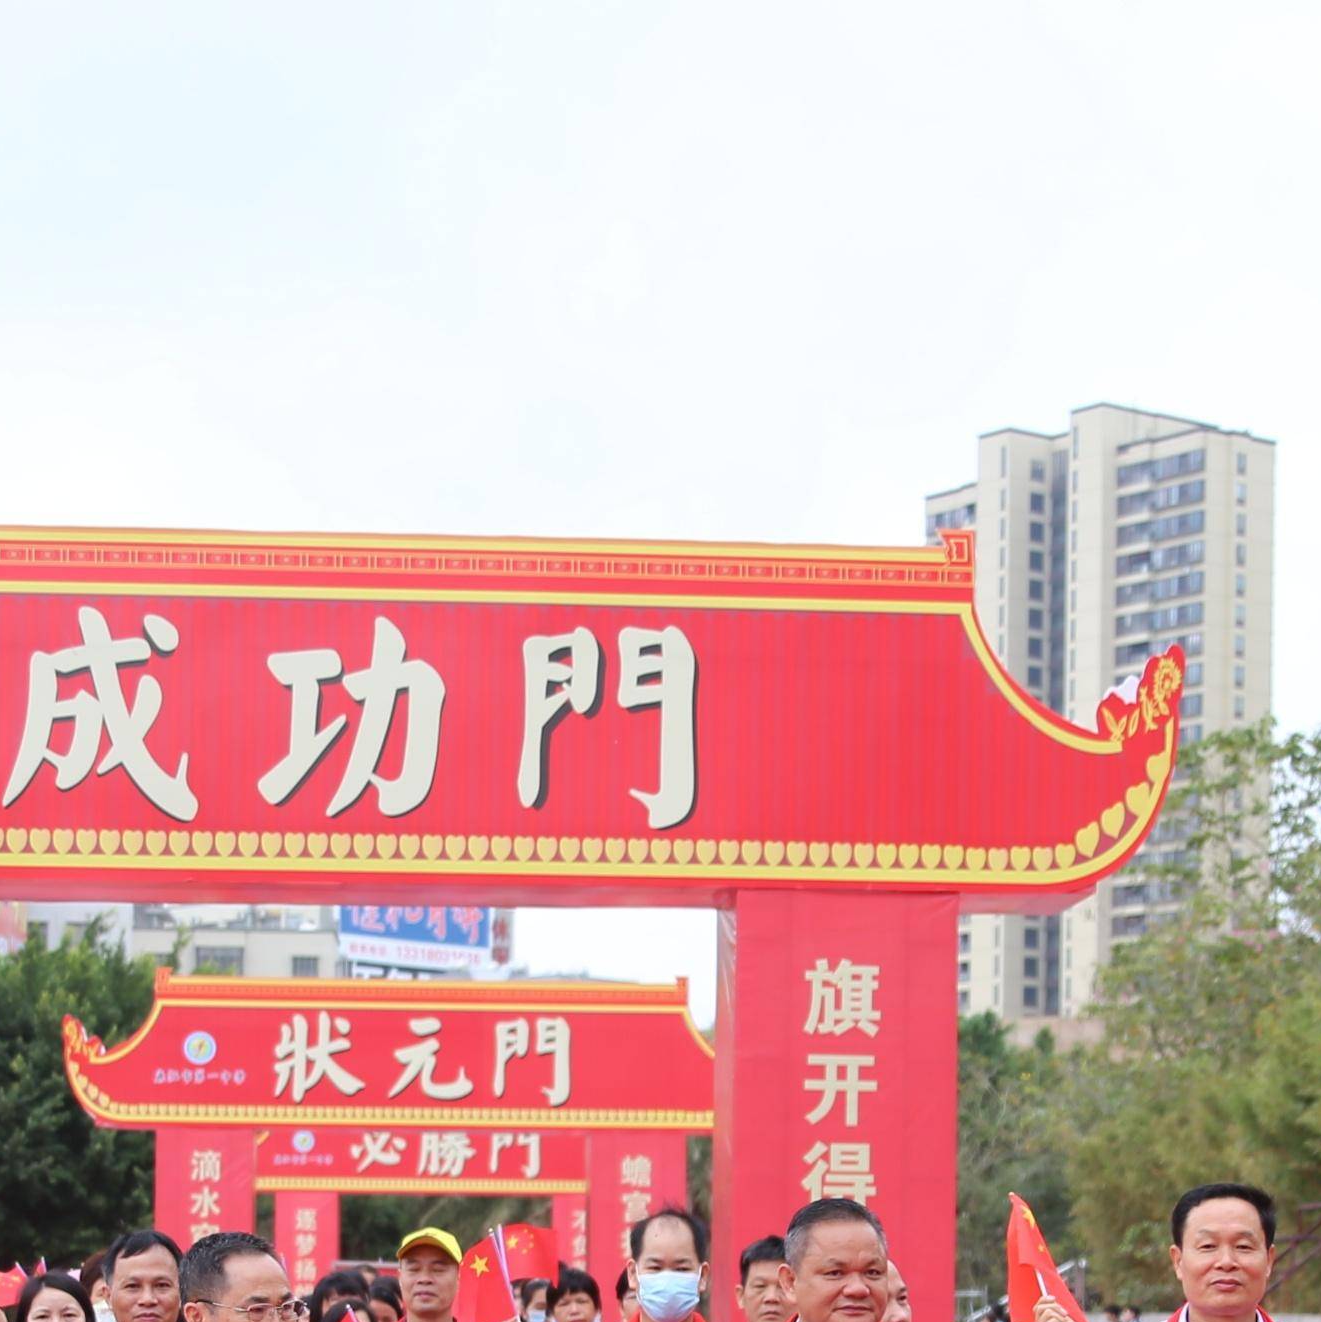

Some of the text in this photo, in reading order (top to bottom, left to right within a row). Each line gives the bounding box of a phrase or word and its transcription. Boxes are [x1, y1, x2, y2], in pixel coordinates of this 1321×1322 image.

[2, 606, 698, 831] 成功門
[801, 958, 882, 1205] 旗开得
